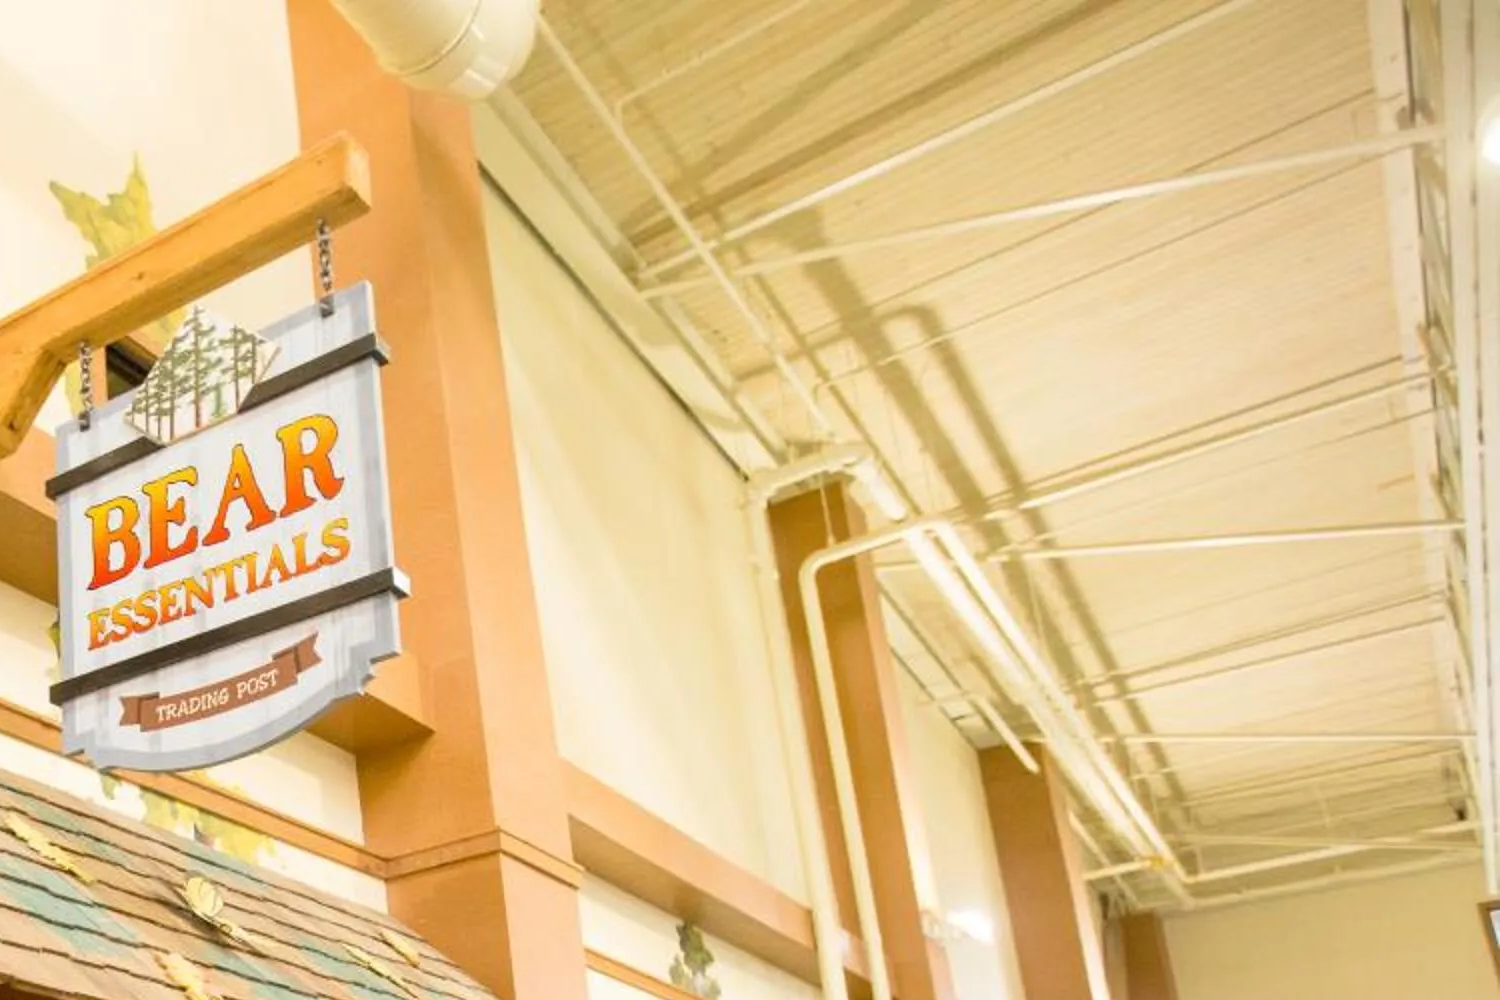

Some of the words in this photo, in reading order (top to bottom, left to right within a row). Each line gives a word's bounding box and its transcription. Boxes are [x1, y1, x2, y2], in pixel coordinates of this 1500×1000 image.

[85, 414, 345, 590] BEAR
[87, 517, 351, 650] ESSENTIALS
[155, 687, 230, 722] TRADING
[235, 669, 278, 699] POST
